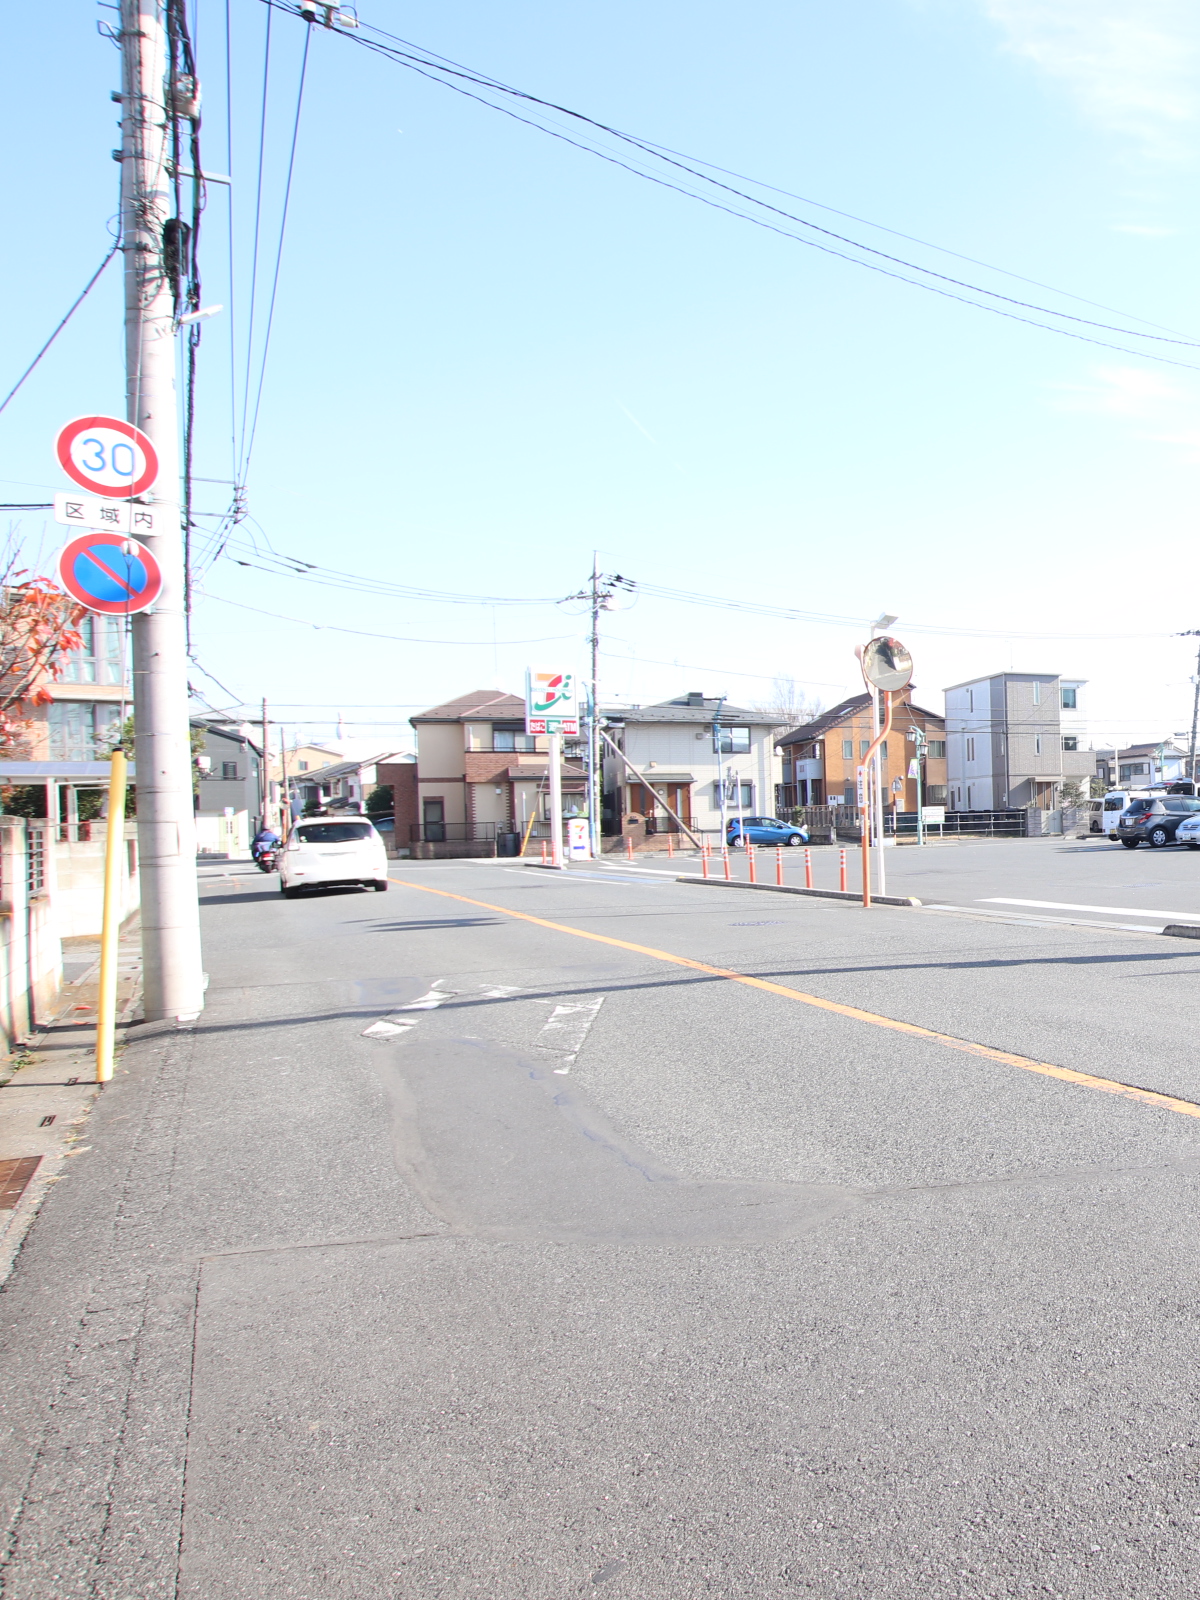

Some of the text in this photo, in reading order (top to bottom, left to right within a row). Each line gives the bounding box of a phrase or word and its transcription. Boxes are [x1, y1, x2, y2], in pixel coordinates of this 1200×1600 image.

[82, 438, 134, 476] 30
[65, 501, 153, 529] 区域内
